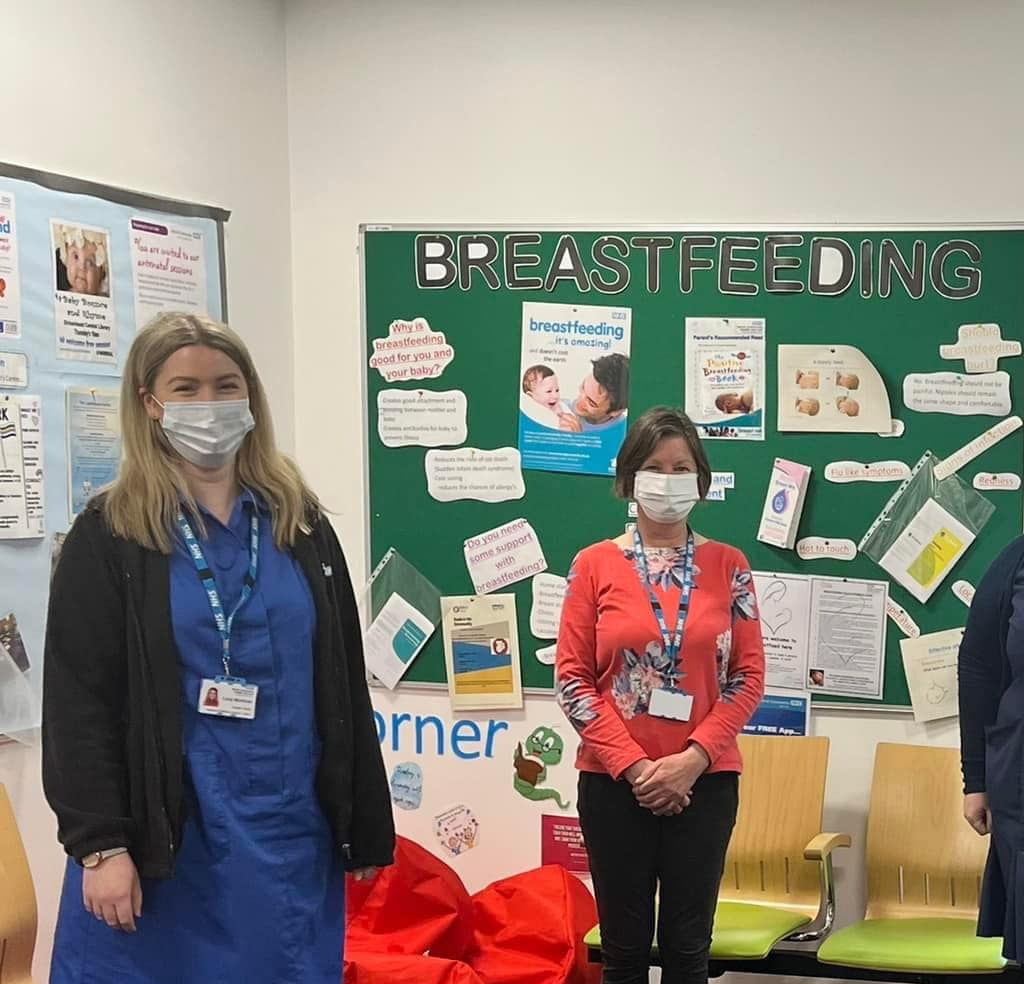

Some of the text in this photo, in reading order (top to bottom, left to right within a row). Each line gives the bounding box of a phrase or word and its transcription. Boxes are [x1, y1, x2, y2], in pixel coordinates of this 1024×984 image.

[415, 233, 982, 300] BREASTFEEDING
[392, 321, 424, 333] Why is
[529, 317, 625, 340] breastfeeding
[376, 335, 444, 350] breastfeeding
[371, 348, 452, 367] good for you and
[386, 363, 441, 380] your baby?
[713, 474, 733, 484] and
[467, 520, 525, 549] Do you need
[468, 532, 533, 563] some support
[495, 555, 515, 569] with
[476, 558, 544, 593] breastfeeding?
